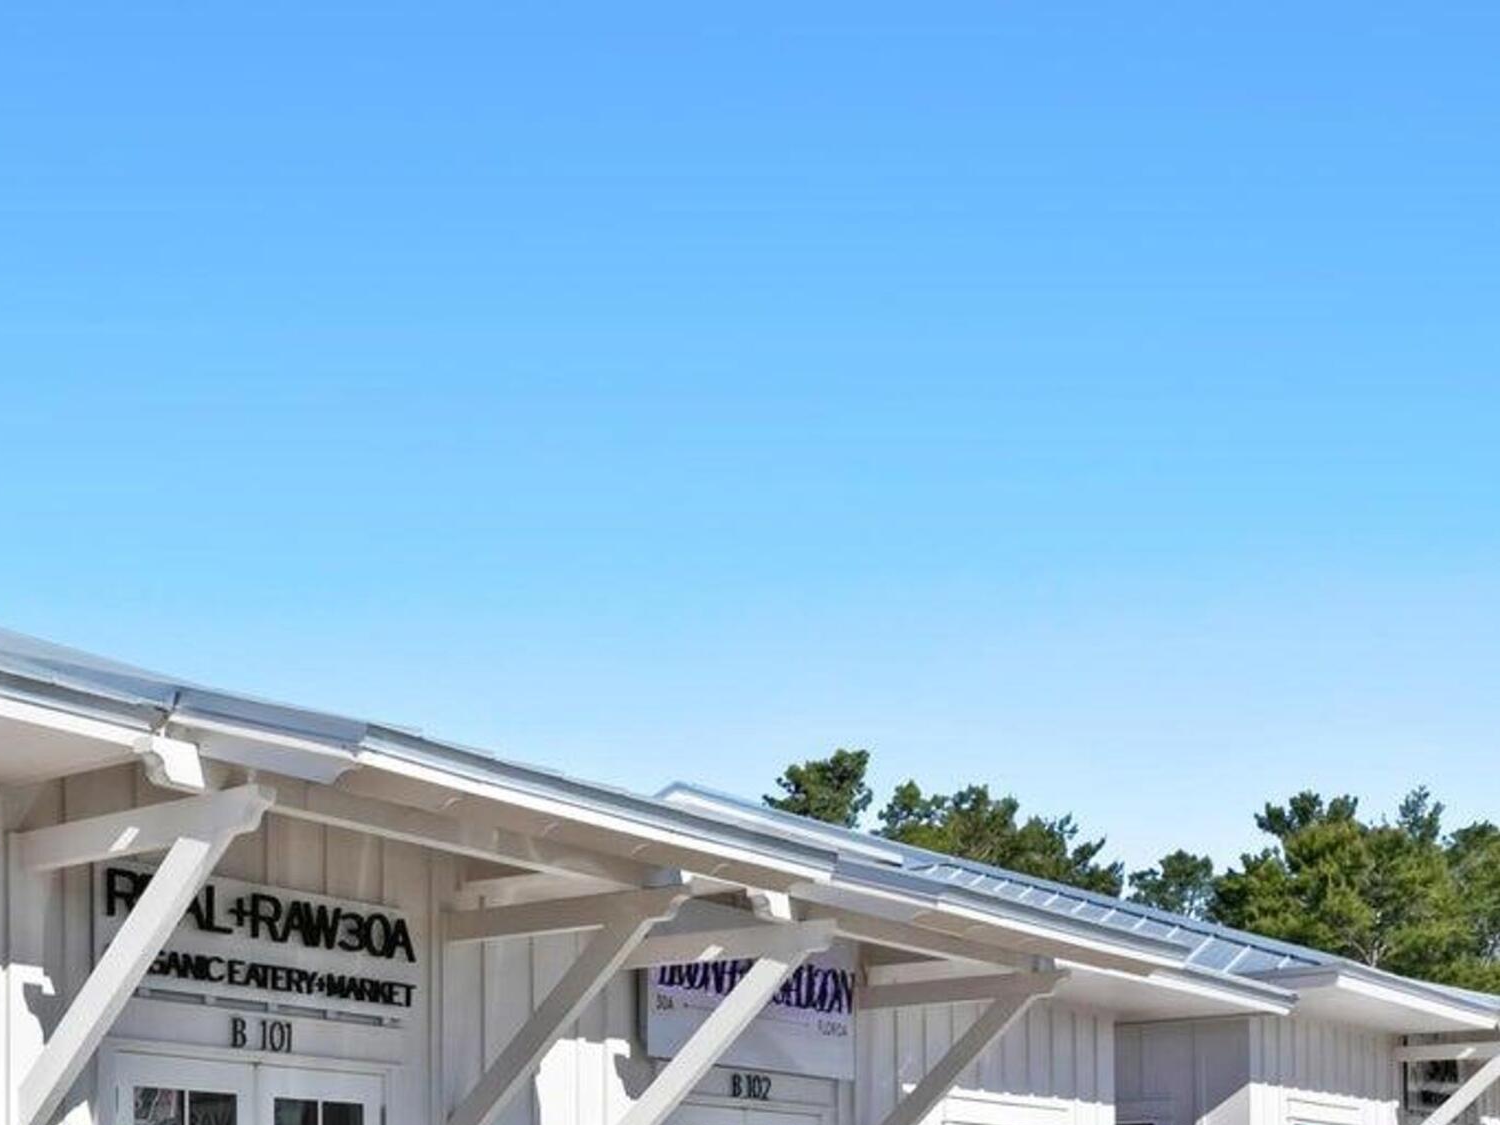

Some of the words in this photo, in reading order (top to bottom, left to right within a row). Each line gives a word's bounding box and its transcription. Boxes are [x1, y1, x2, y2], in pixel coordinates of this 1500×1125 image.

[231, 1017, 247, 1048] B
[261, 1020, 293, 1053] 101
[731, 1074, 742, 1097] B
[745, 1075, 772, 1100] 102
